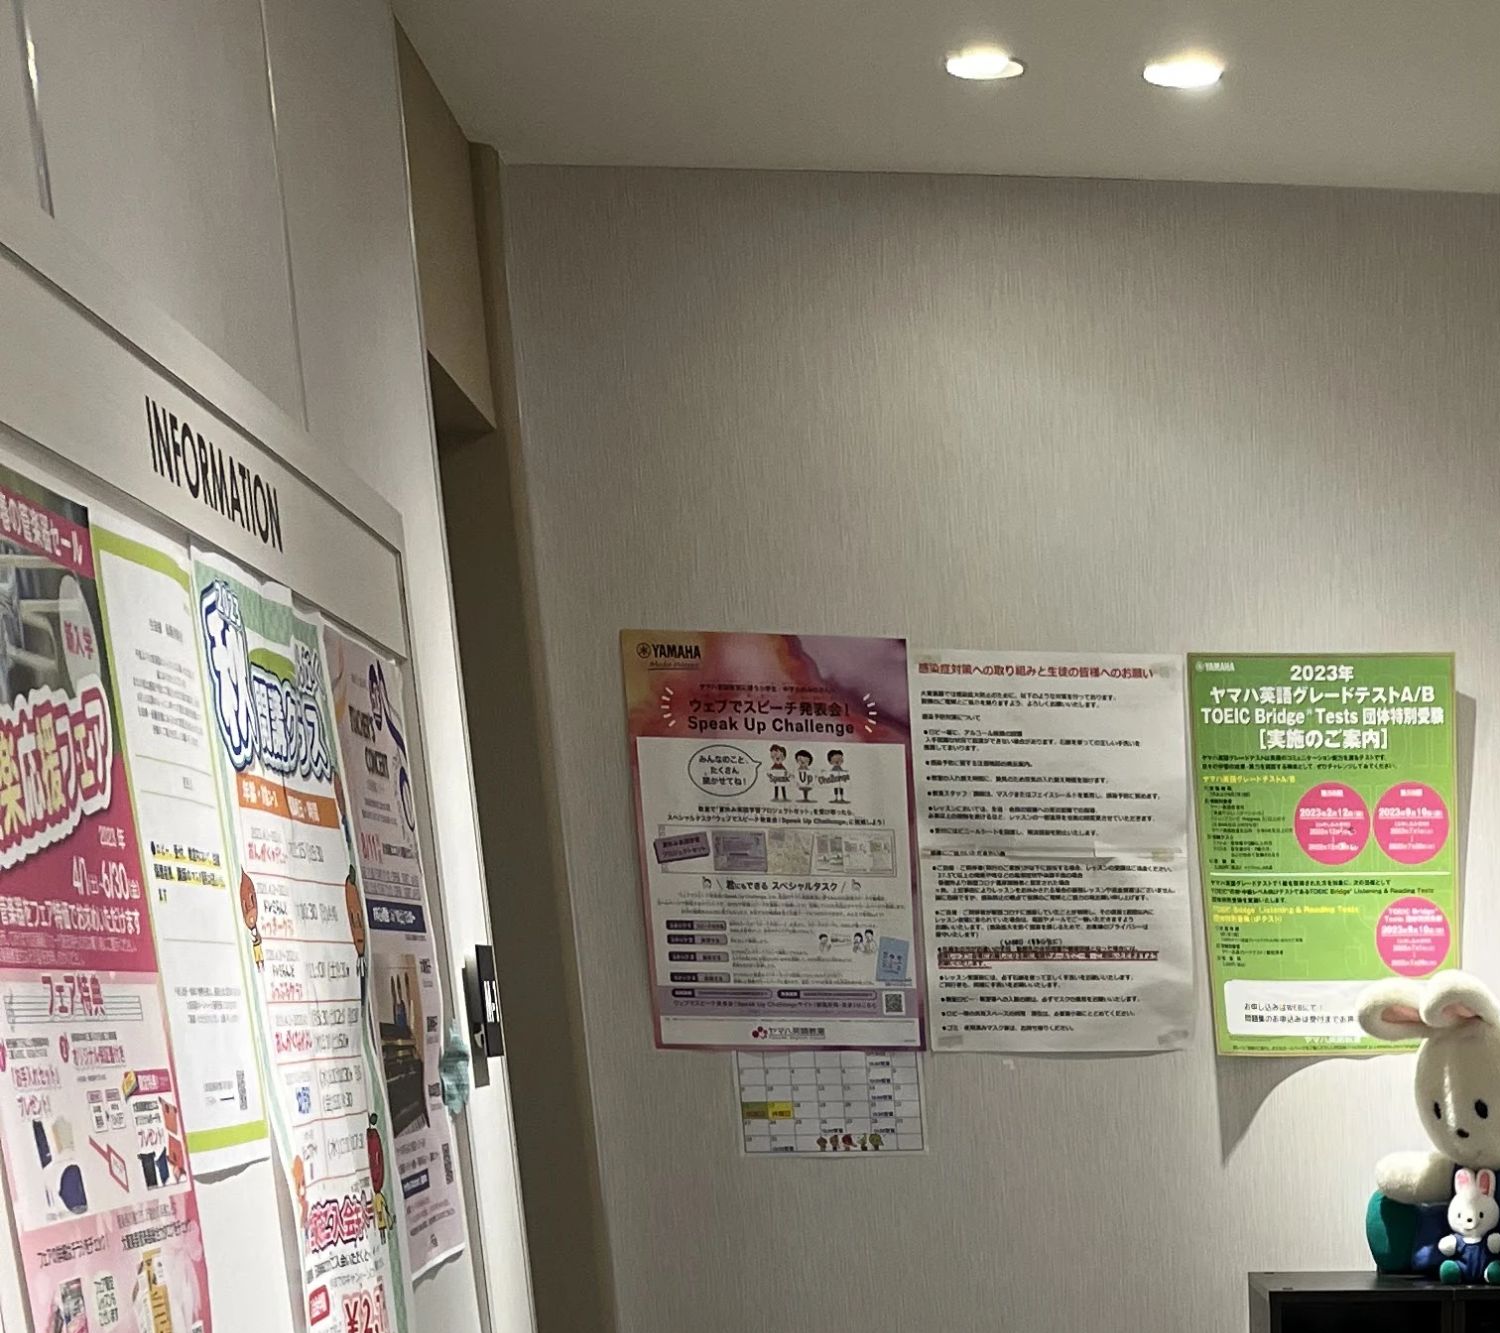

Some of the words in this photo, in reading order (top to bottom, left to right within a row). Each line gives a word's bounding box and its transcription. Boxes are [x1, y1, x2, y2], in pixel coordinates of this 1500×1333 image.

[145, 395, 283, 553] INFORMATION
[652, 644, 701, 659] YAMAHA
[1204, 662, 1235, 672] YAMAHA
[1290, 665, 1354, 683] 2023年
[1210, 685, 1435, 705] ヤマハ英語グレードテストA/B
[1201, 708, 1250, 725] TOEIC
[1316, 708, 1358, 724] Tests
[1363, 708, 1445, 725] 団体特別受験
[688, 716, 738, 732] Speak
[744, 718, 766, 736] Up
[772, 718, 854, 736] Challenge
[799, 772, 814, 784] Up
